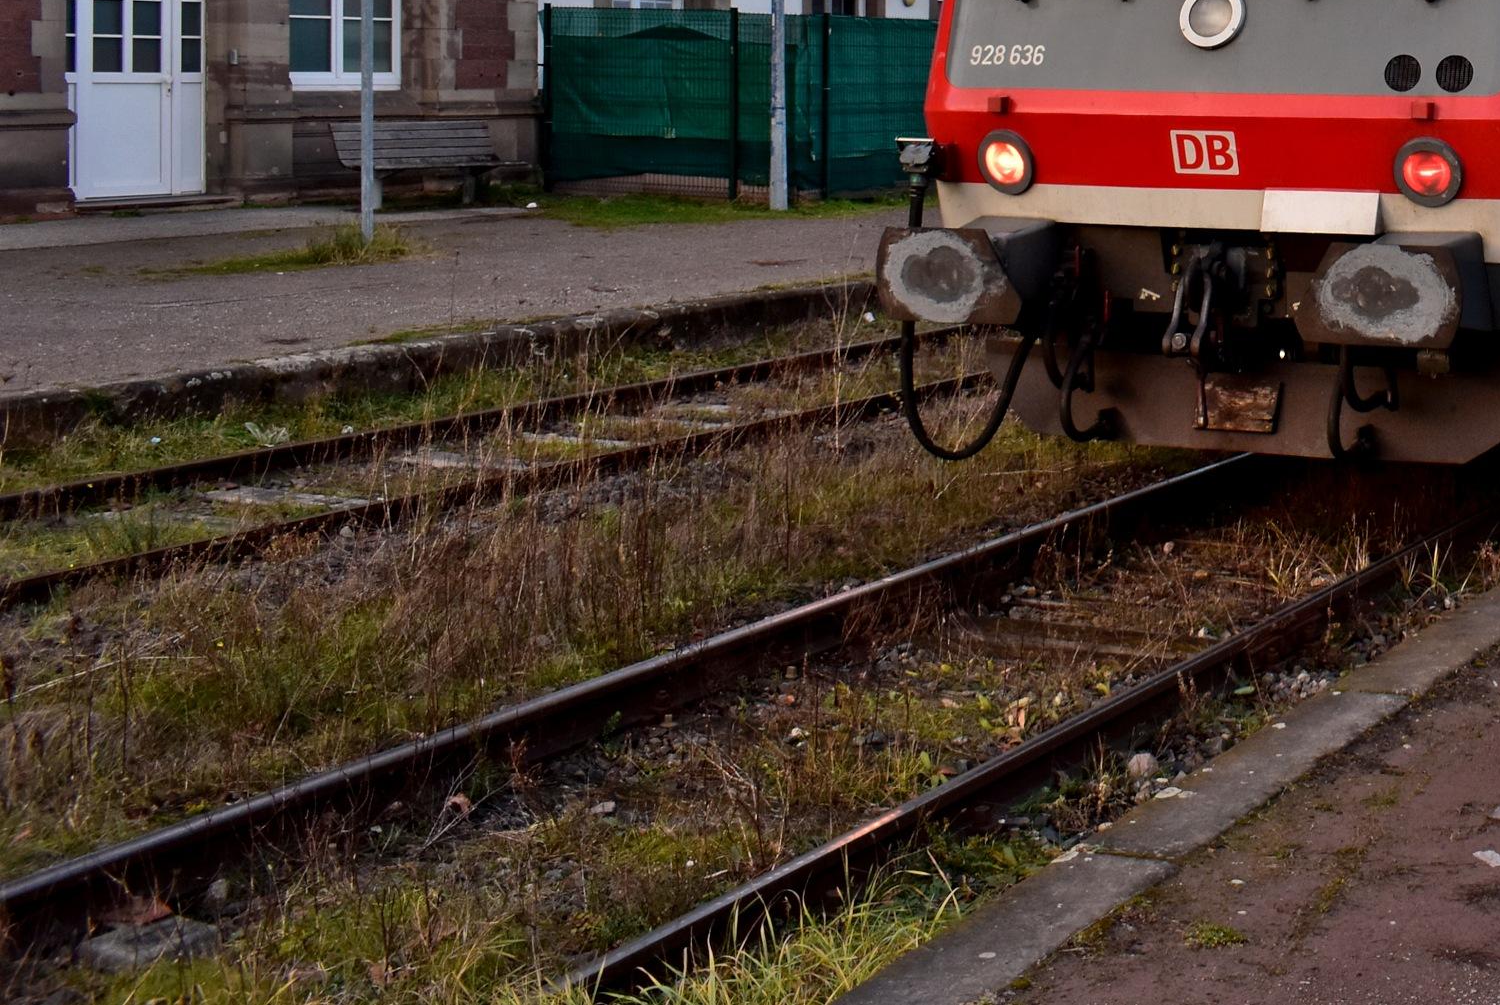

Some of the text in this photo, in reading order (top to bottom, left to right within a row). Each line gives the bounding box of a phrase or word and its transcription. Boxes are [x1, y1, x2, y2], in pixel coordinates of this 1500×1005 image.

[970, 44, 1045, 65] 928 636
[1176, 134, 1234, 170] DB
